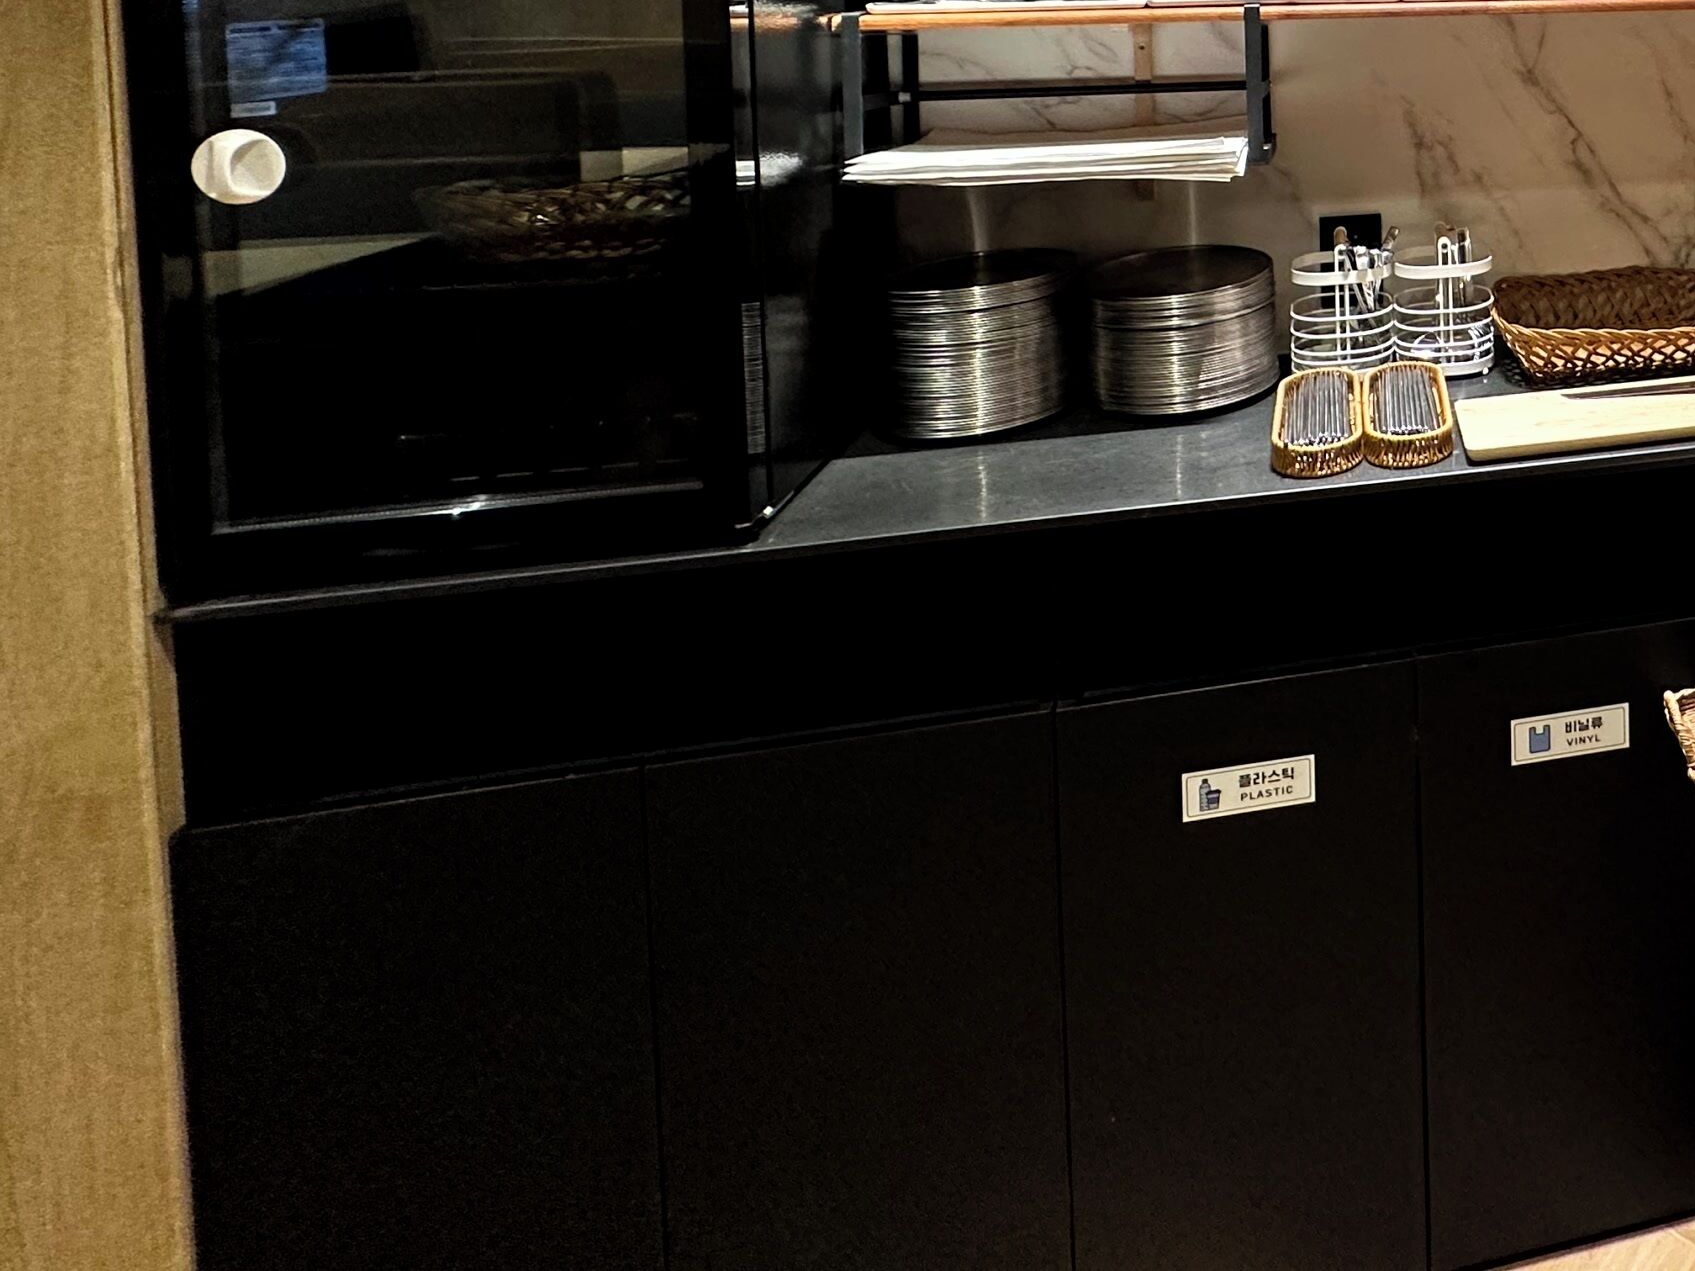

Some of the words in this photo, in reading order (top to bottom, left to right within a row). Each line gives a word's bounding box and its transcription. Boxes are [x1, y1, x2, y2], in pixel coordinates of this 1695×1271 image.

[1566, 734, 1601, 746] VINYL
[1239, 767, 1295, 788] 플라스틱
[1240, 785, 1294, 801] PLASTIC
